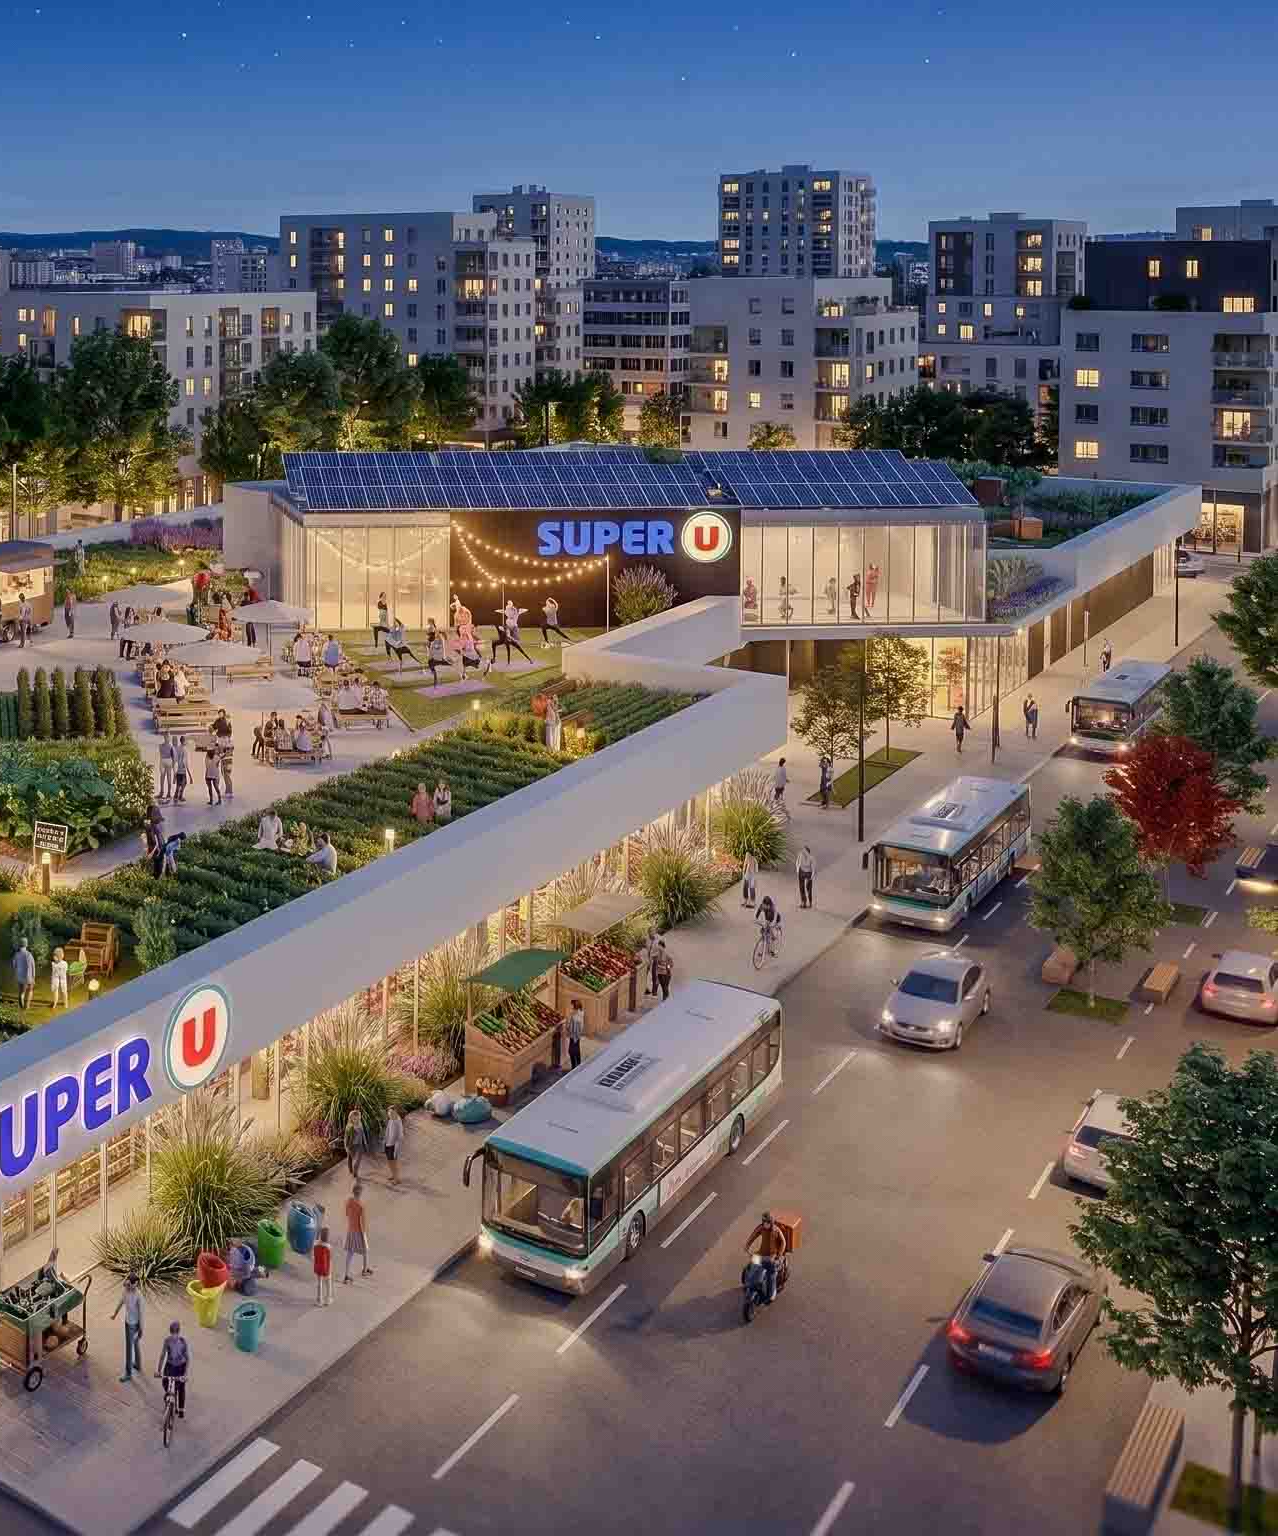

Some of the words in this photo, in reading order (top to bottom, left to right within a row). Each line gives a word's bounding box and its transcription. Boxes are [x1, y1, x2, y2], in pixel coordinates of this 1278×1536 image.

[537, 520, 675, 556] SUPER
[693, 526, 719, 552] U
[182, 1007, 217, 1068] U
